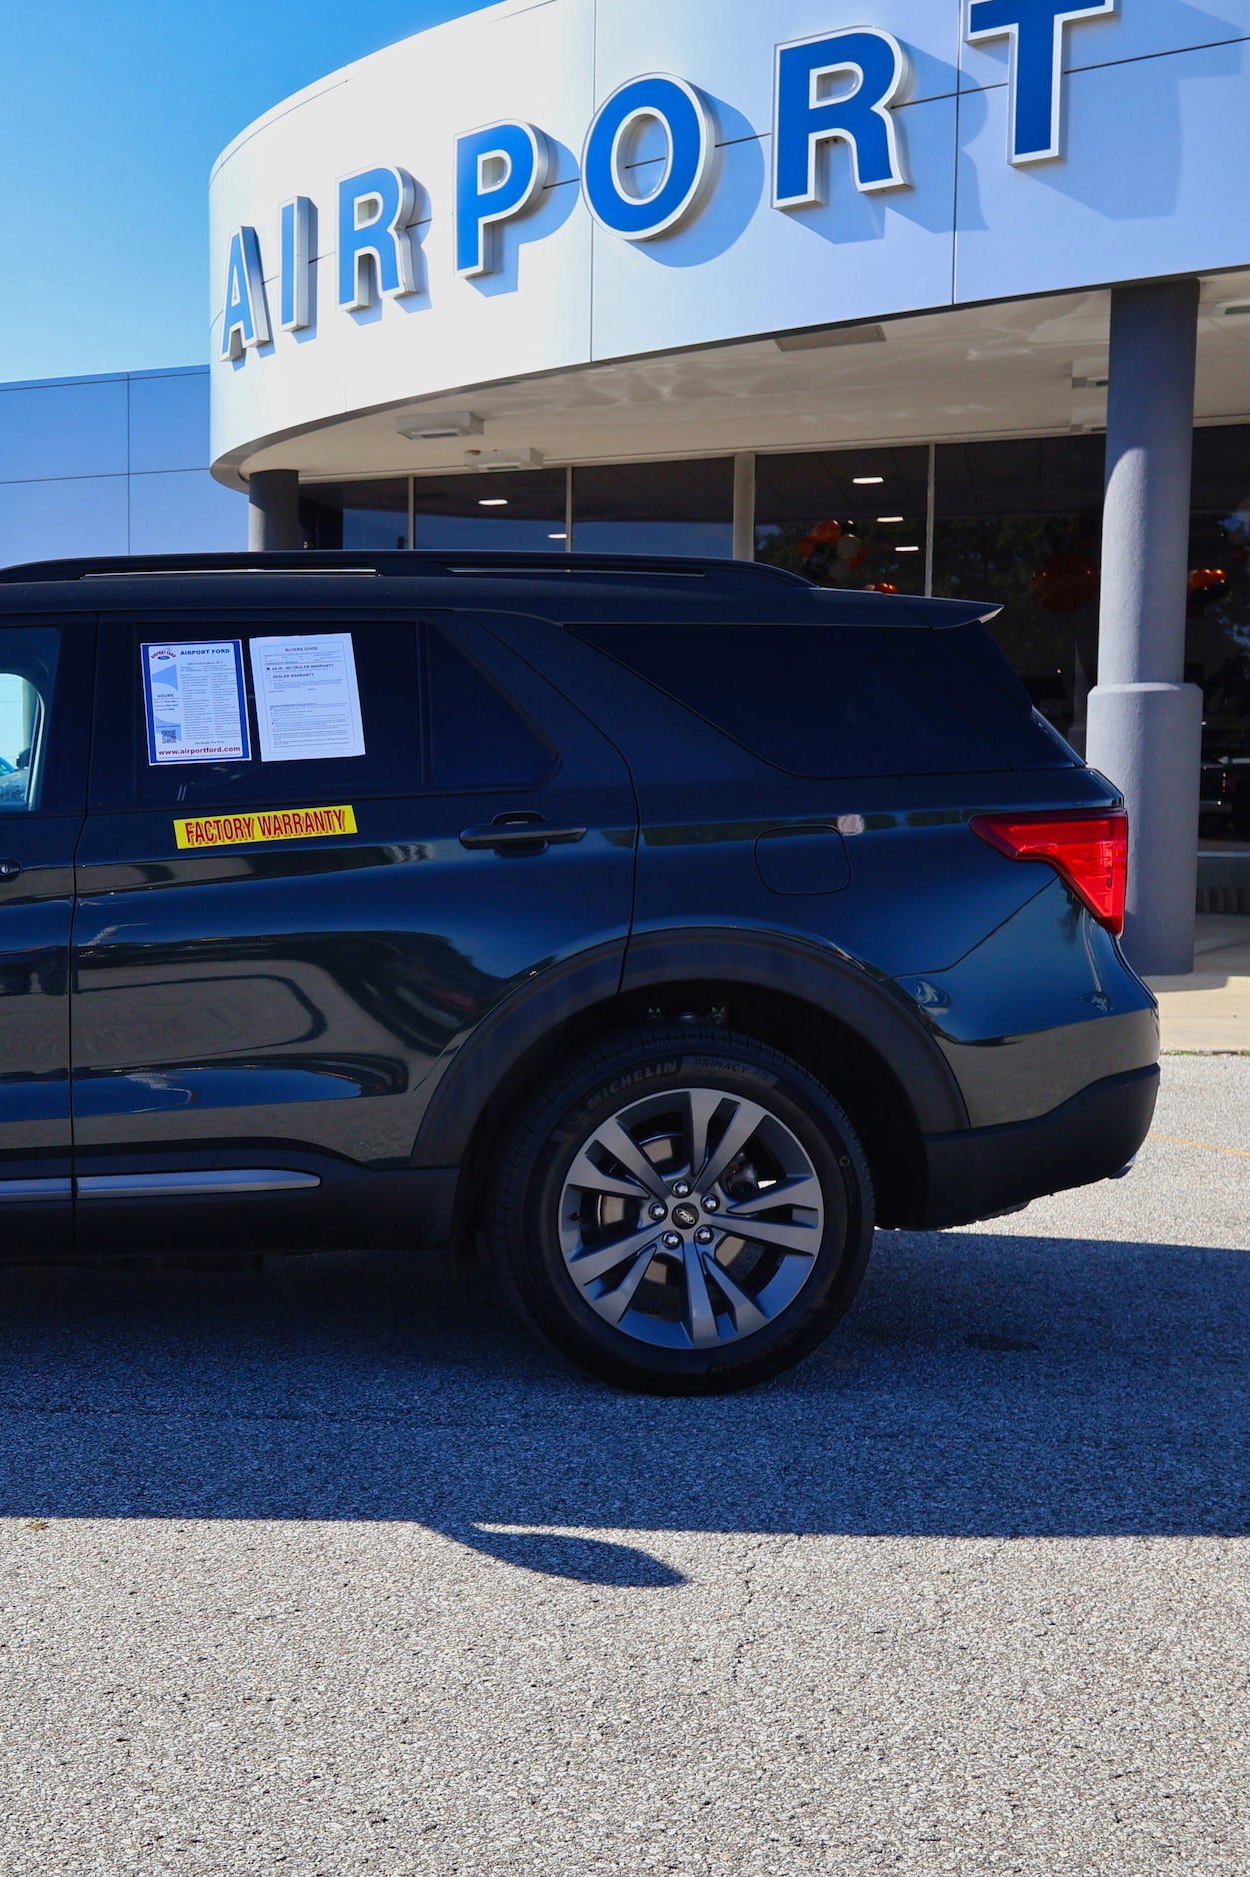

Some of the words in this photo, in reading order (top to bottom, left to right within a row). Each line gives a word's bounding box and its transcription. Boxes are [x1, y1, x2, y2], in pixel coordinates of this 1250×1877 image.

[221, 0, 1116, 362] AIRPORT
[158, 746, 241, 756] www.airportford.com
[184, 816, 254, 845] FACTORY
[257, 809, 346, 838] WARRANTY
[586, 1060, 679, 1108] MICHELIN
[694, 1058, 750, 1074] PRIMACY
